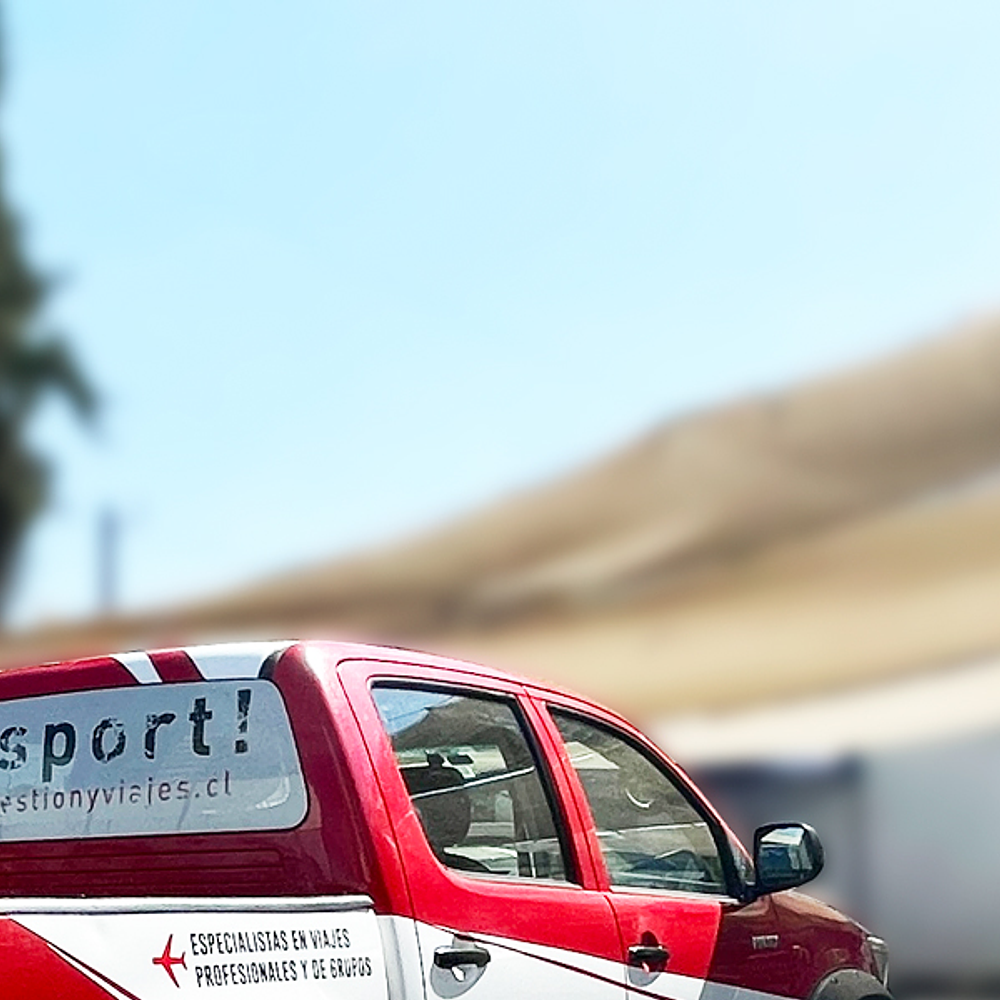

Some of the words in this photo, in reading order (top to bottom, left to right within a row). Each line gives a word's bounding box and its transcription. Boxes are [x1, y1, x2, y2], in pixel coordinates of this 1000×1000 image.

[190, 931, 288, 955] ESPECIALISTAS
[291, 930, 308, 951] EN
[309, 928, 351, 949] VIAJES
[195, 960, 298, 988] PROFESIONALES
[300, 959, 308, 981] Y
[312, 958, 327, 980] DE
[330, 956, 372, 979] GRUPOS
